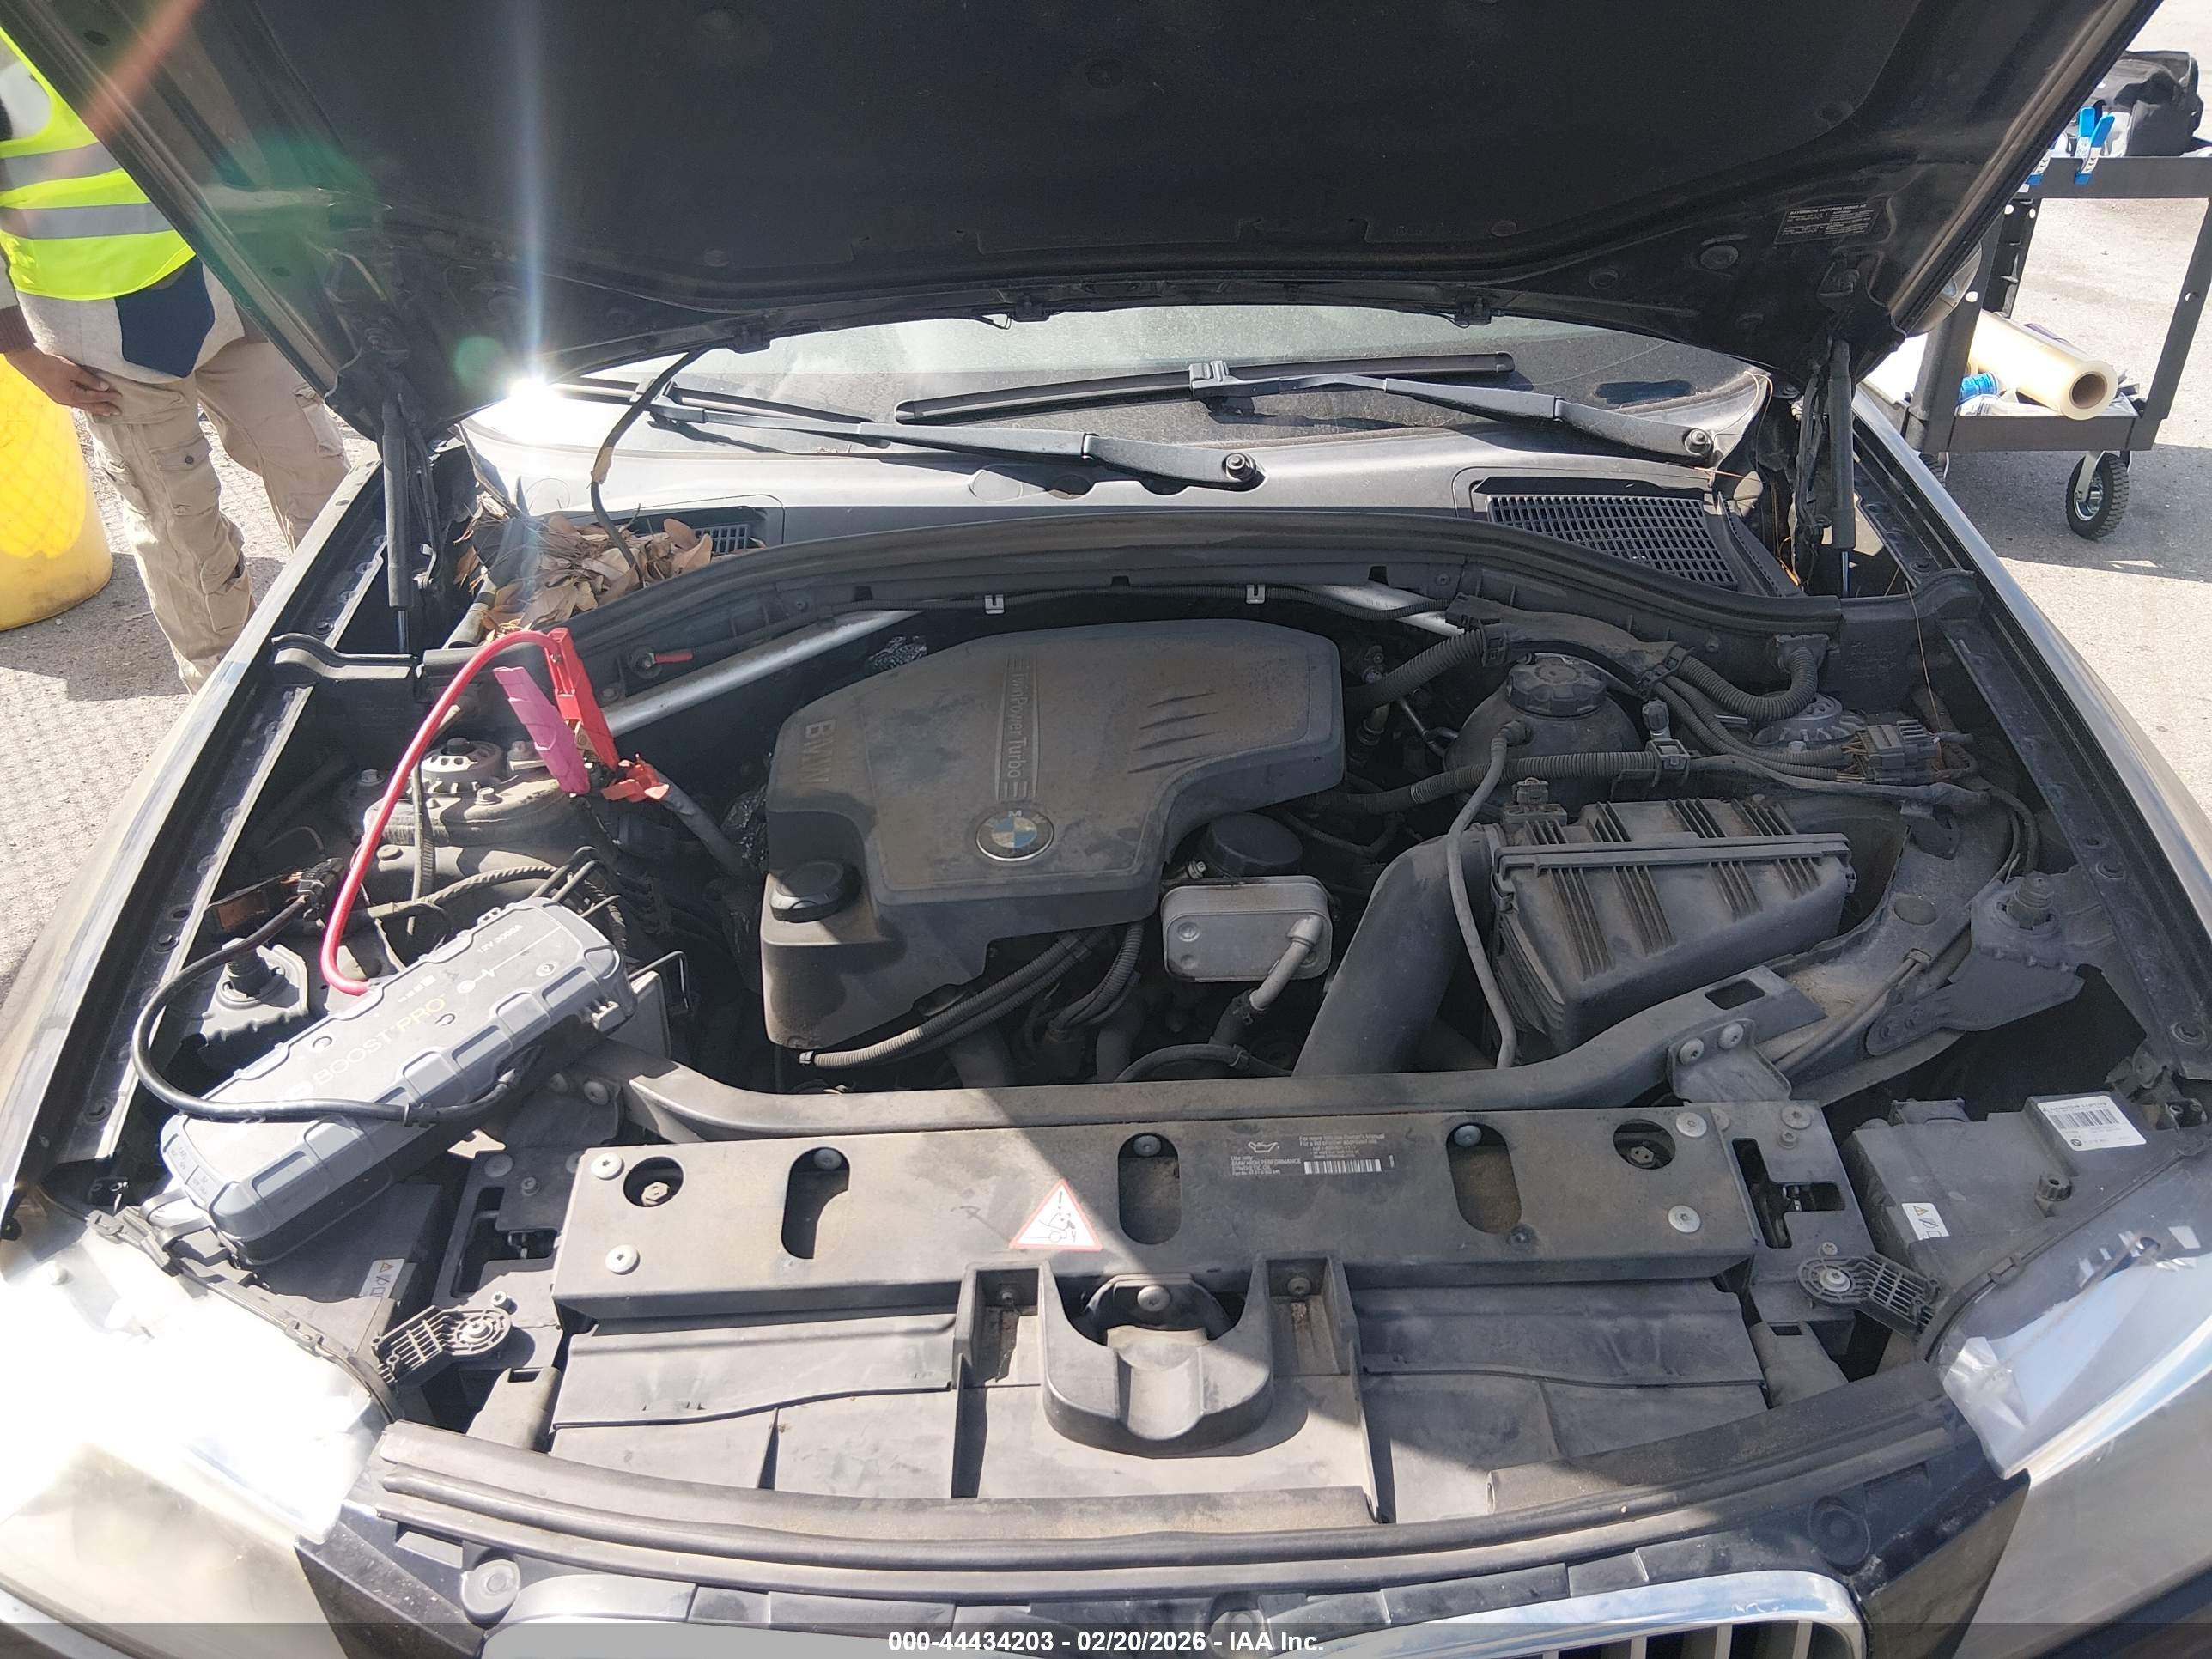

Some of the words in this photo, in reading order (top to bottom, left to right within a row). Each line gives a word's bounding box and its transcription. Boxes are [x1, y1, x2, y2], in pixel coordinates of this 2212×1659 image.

[1010, 673, 1028, 735] TwinPower
[1007, 736, 1028, 779] Turbo
[314, 1030, 392, 1086] BOOST
[395, 997, 445, 1031] PRO
